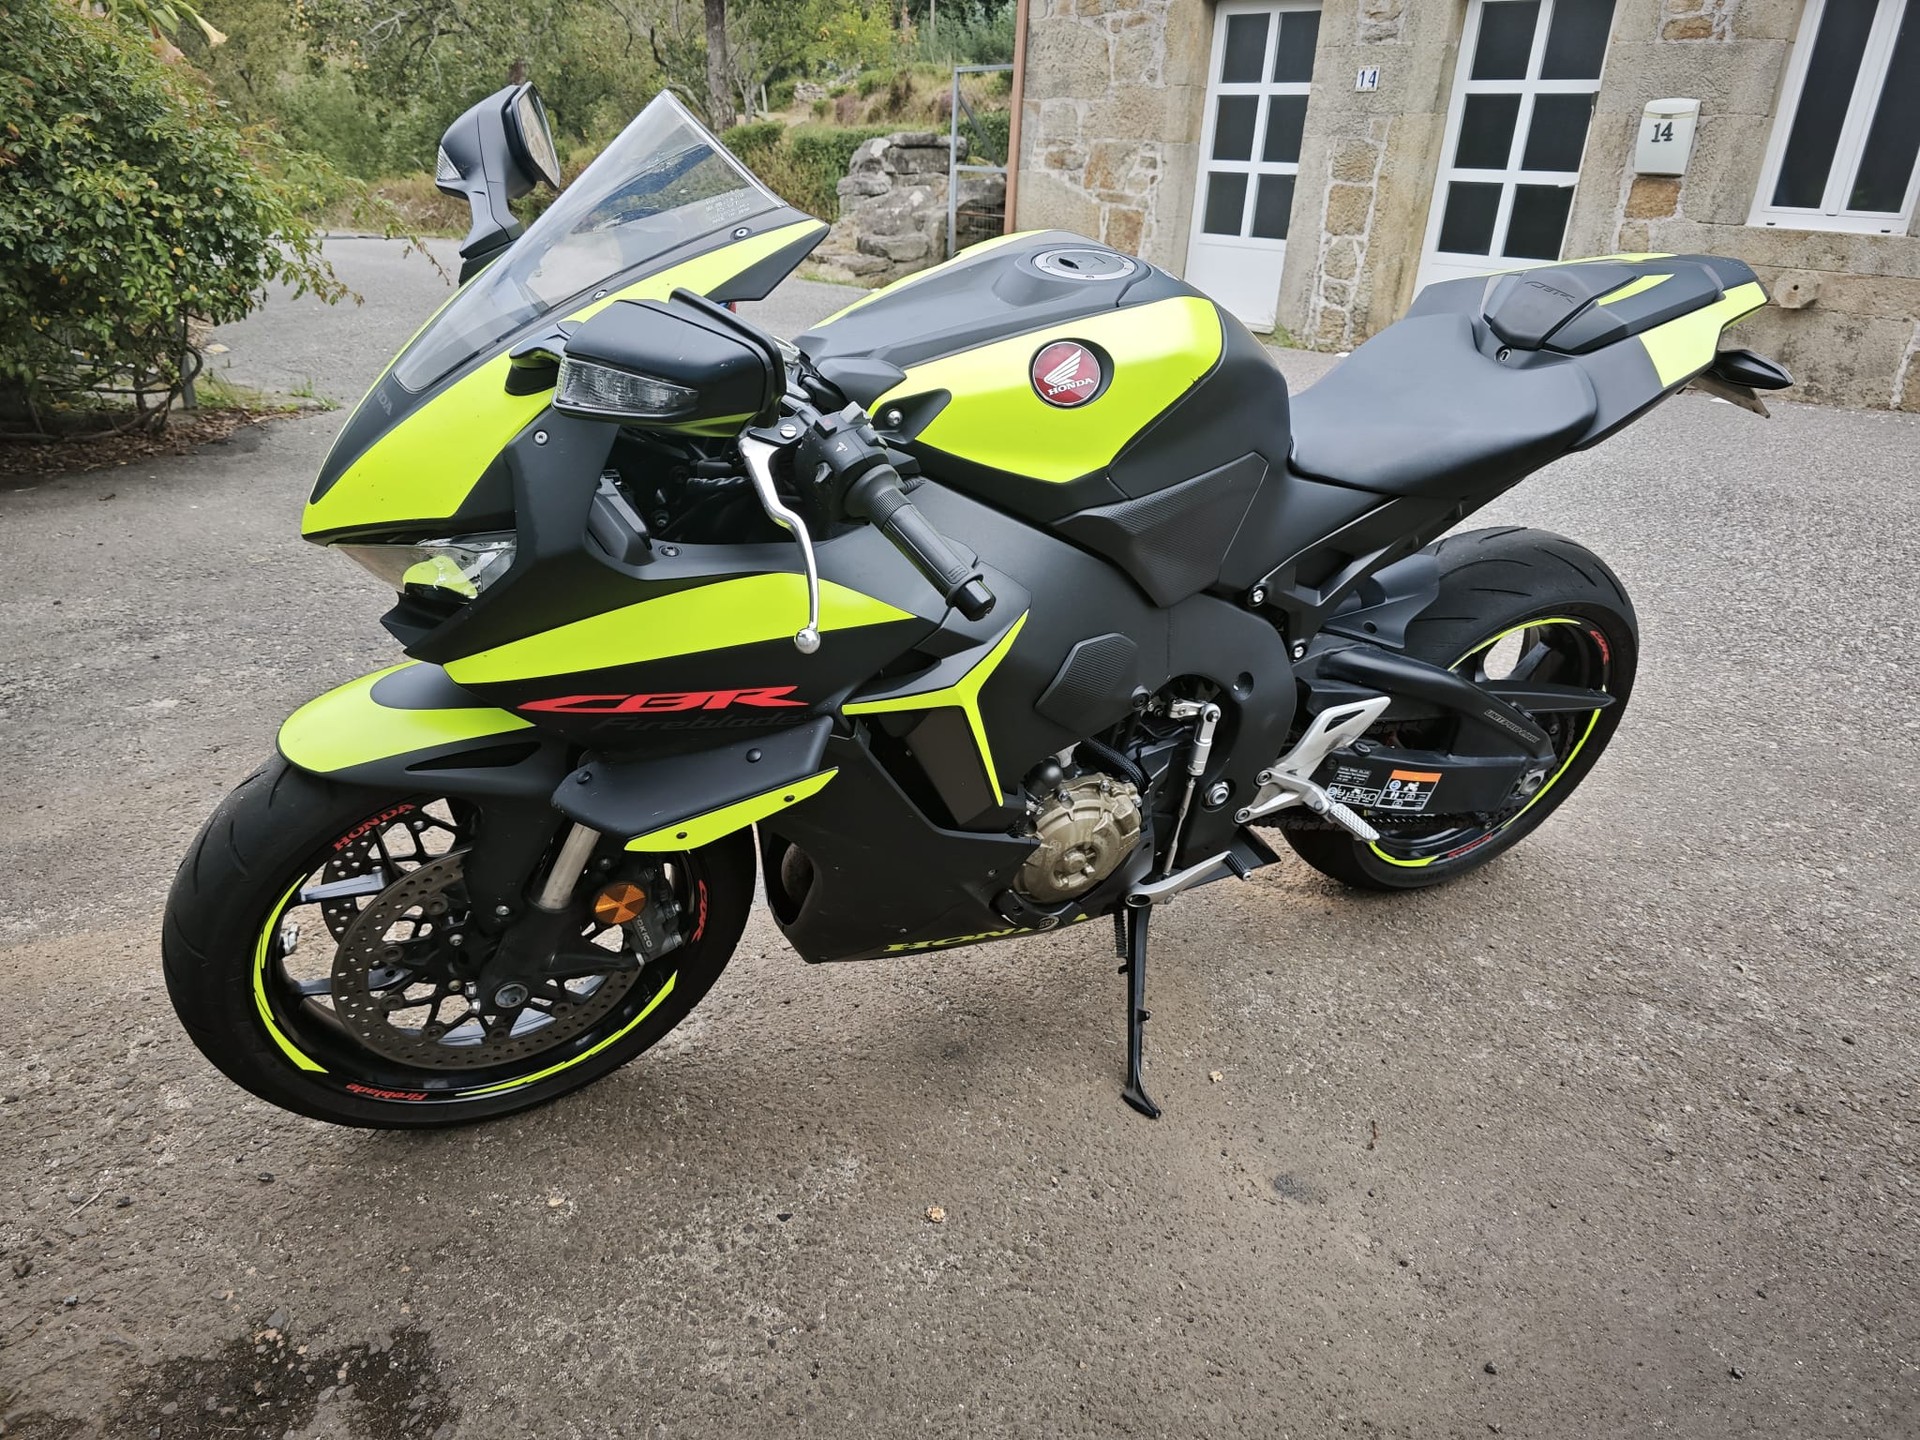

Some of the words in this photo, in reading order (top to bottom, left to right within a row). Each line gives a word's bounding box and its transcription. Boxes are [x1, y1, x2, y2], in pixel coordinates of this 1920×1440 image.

[1359, 70, 1377, 88] 14
[1651, 121, 1674, 143] 14
[1047, 377, 1095, 396] HONDA
[517, 686, 810, 713] CBR
[590, 711, 806, 732] Fireblade
[332, 803, 416, 851] HONDA
